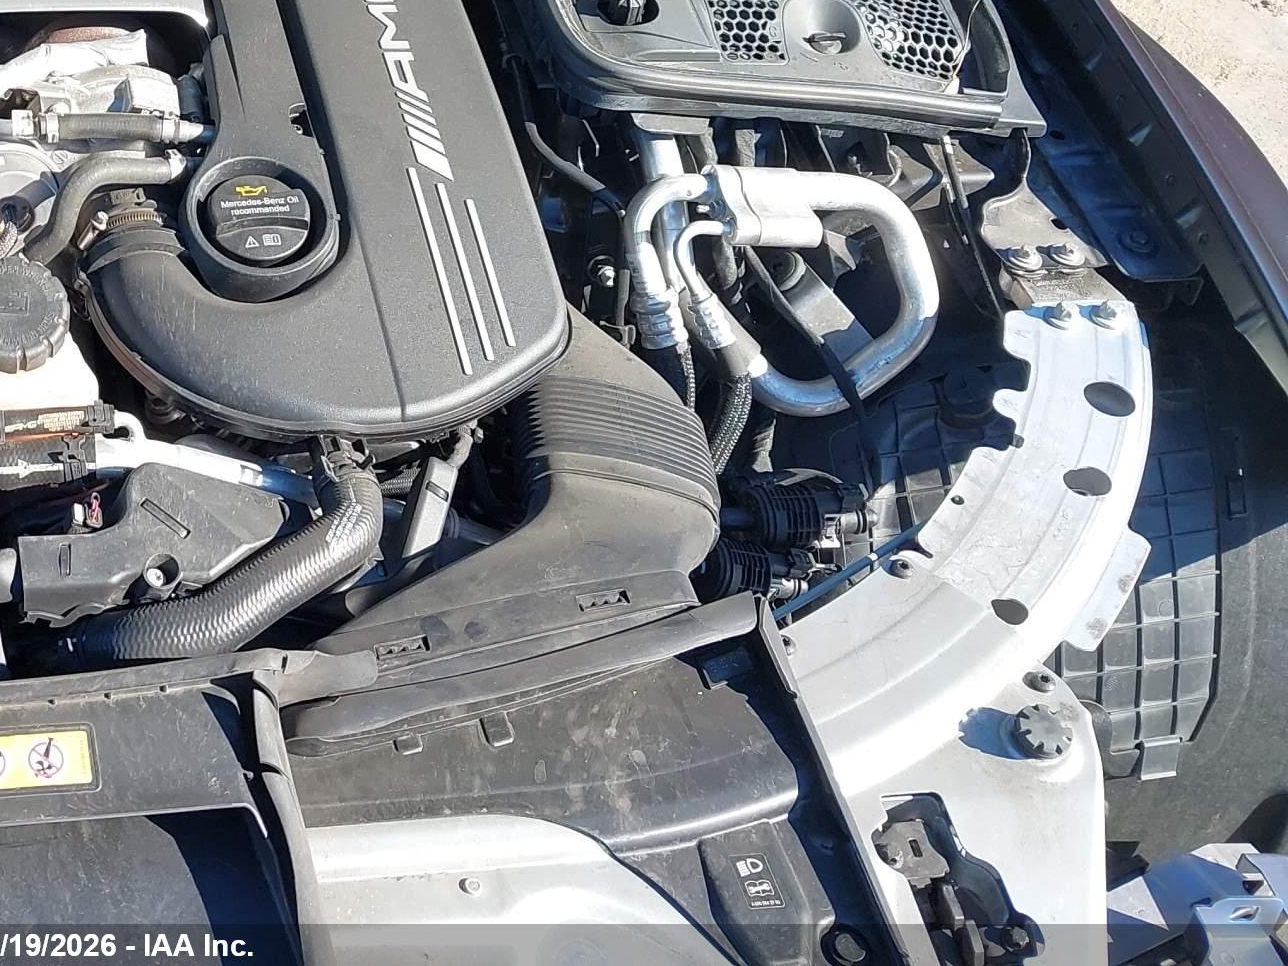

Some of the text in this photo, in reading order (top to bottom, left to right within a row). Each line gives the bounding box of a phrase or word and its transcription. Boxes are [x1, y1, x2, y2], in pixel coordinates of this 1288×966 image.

[220, 195, 300, 209] Mercedes-Benz Oil
[230, 205, 290, 216] recommended
